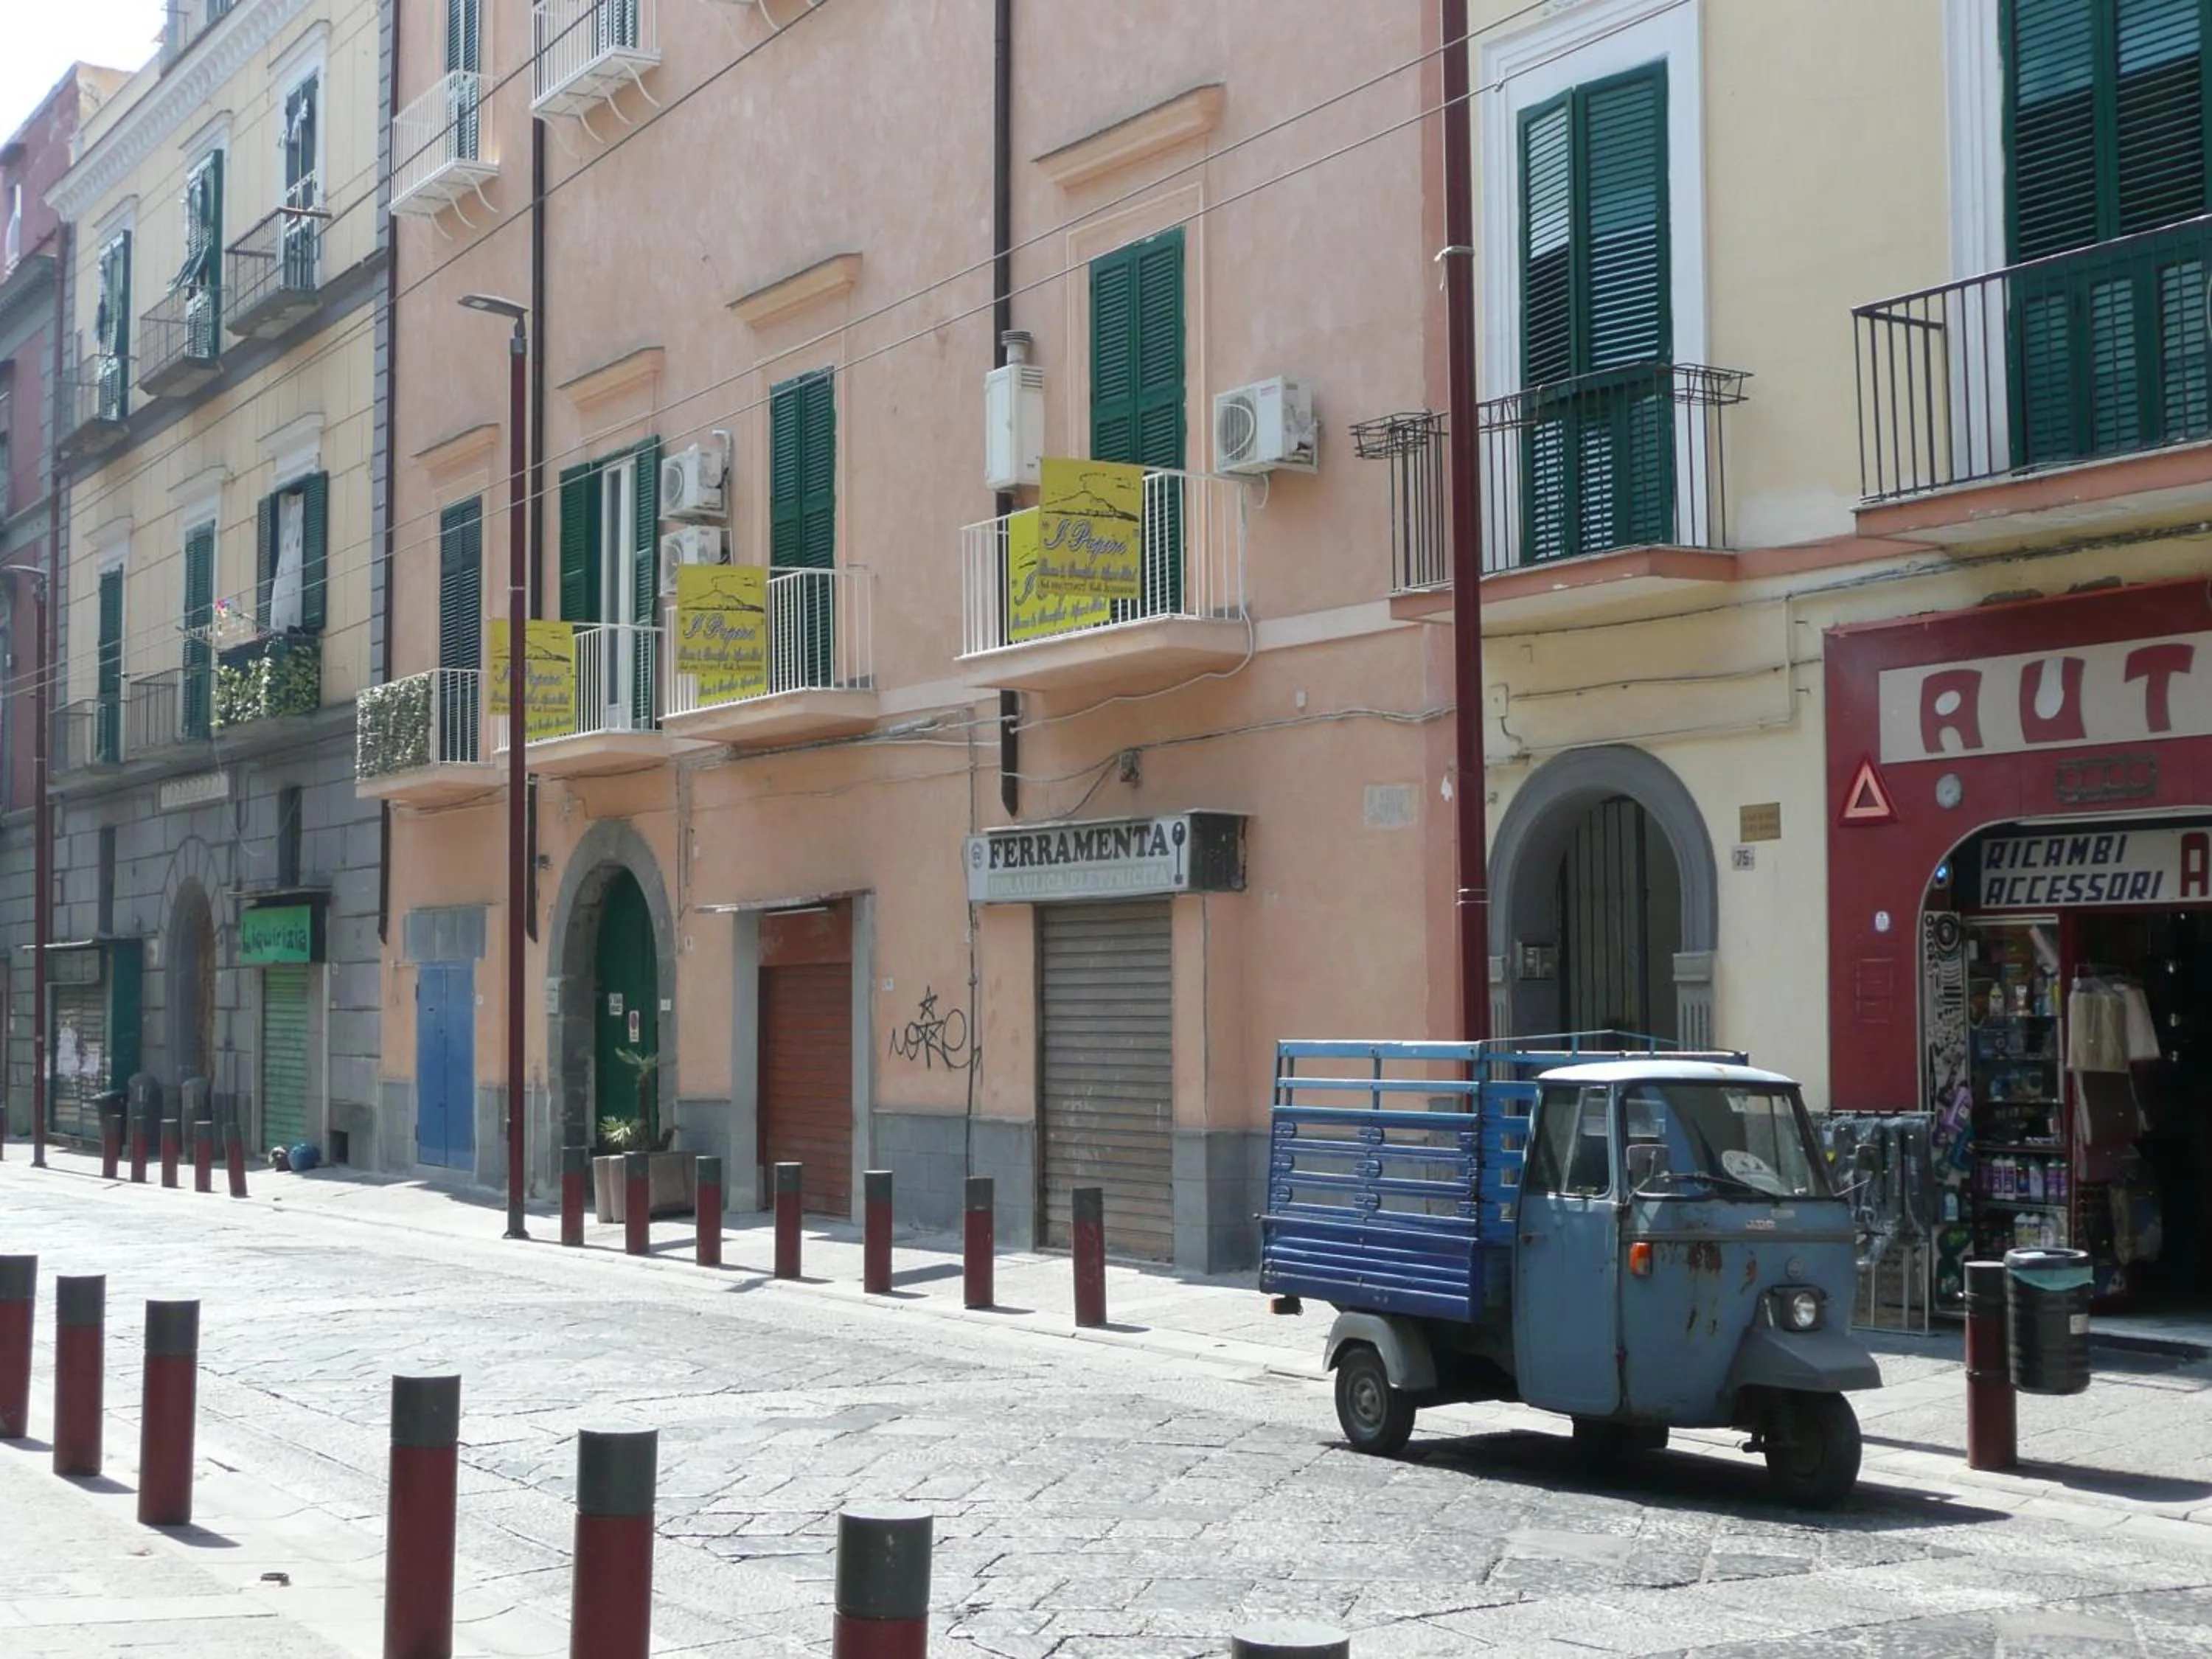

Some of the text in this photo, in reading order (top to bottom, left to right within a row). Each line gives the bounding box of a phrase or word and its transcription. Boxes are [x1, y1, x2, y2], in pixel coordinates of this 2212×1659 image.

[988, 823, 1169, 869] FERRAMENTA
[1984, 834, 2128, 870] RICAMBI
[1983, 871, 2163, 906] ACCESSORI
